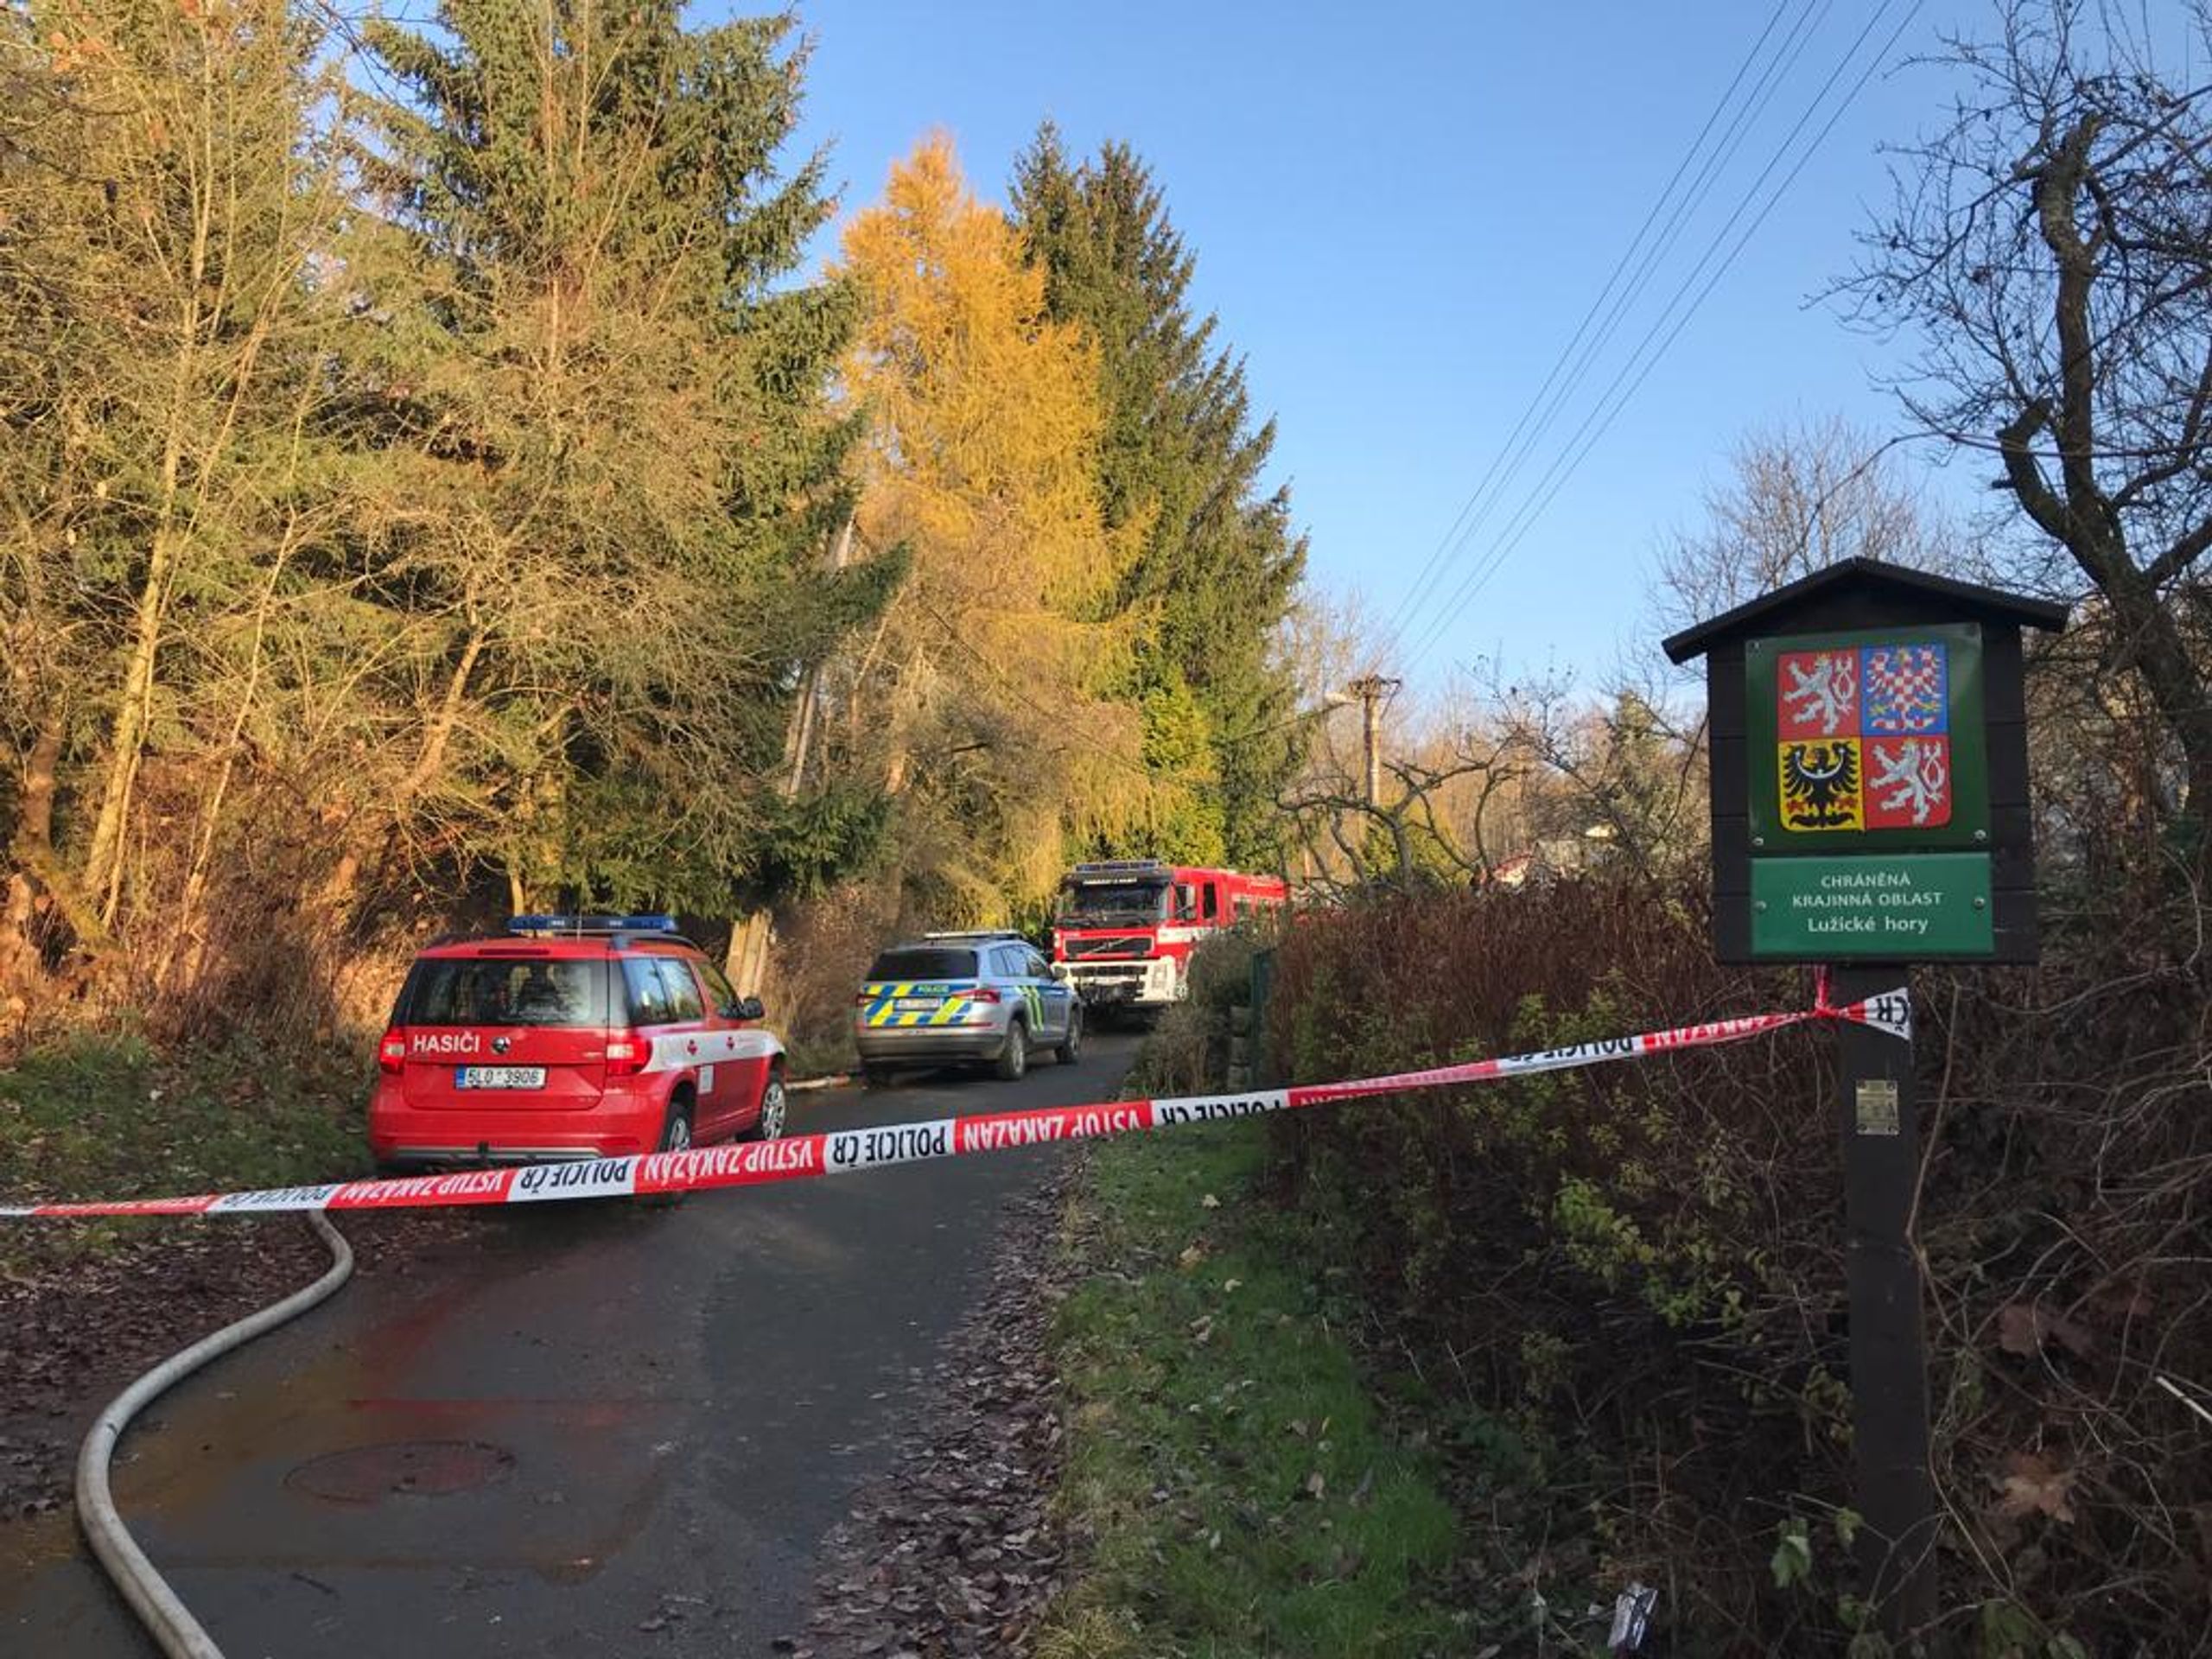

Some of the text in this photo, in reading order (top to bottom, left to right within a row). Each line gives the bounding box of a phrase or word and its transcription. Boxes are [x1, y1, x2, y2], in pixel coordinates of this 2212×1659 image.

[1821, 871, 1910, 888] CHRÁNĚNÁ
[1792, 892, 1943, 909] KRAJINNÁ OBLAST
[1808, 914, 1929, 934] Lužické hory
[412, 1031, 480, 1053] HASIČI
[832, 1126, 946, 1167] POLICIE ČR
[643, 1140, 814, 1185] VSTUP ZAKÁZÁN
[438, 1171, 502, 1195] VSTUP
[520, 1159, 630, 1193] POLICIE ČR
